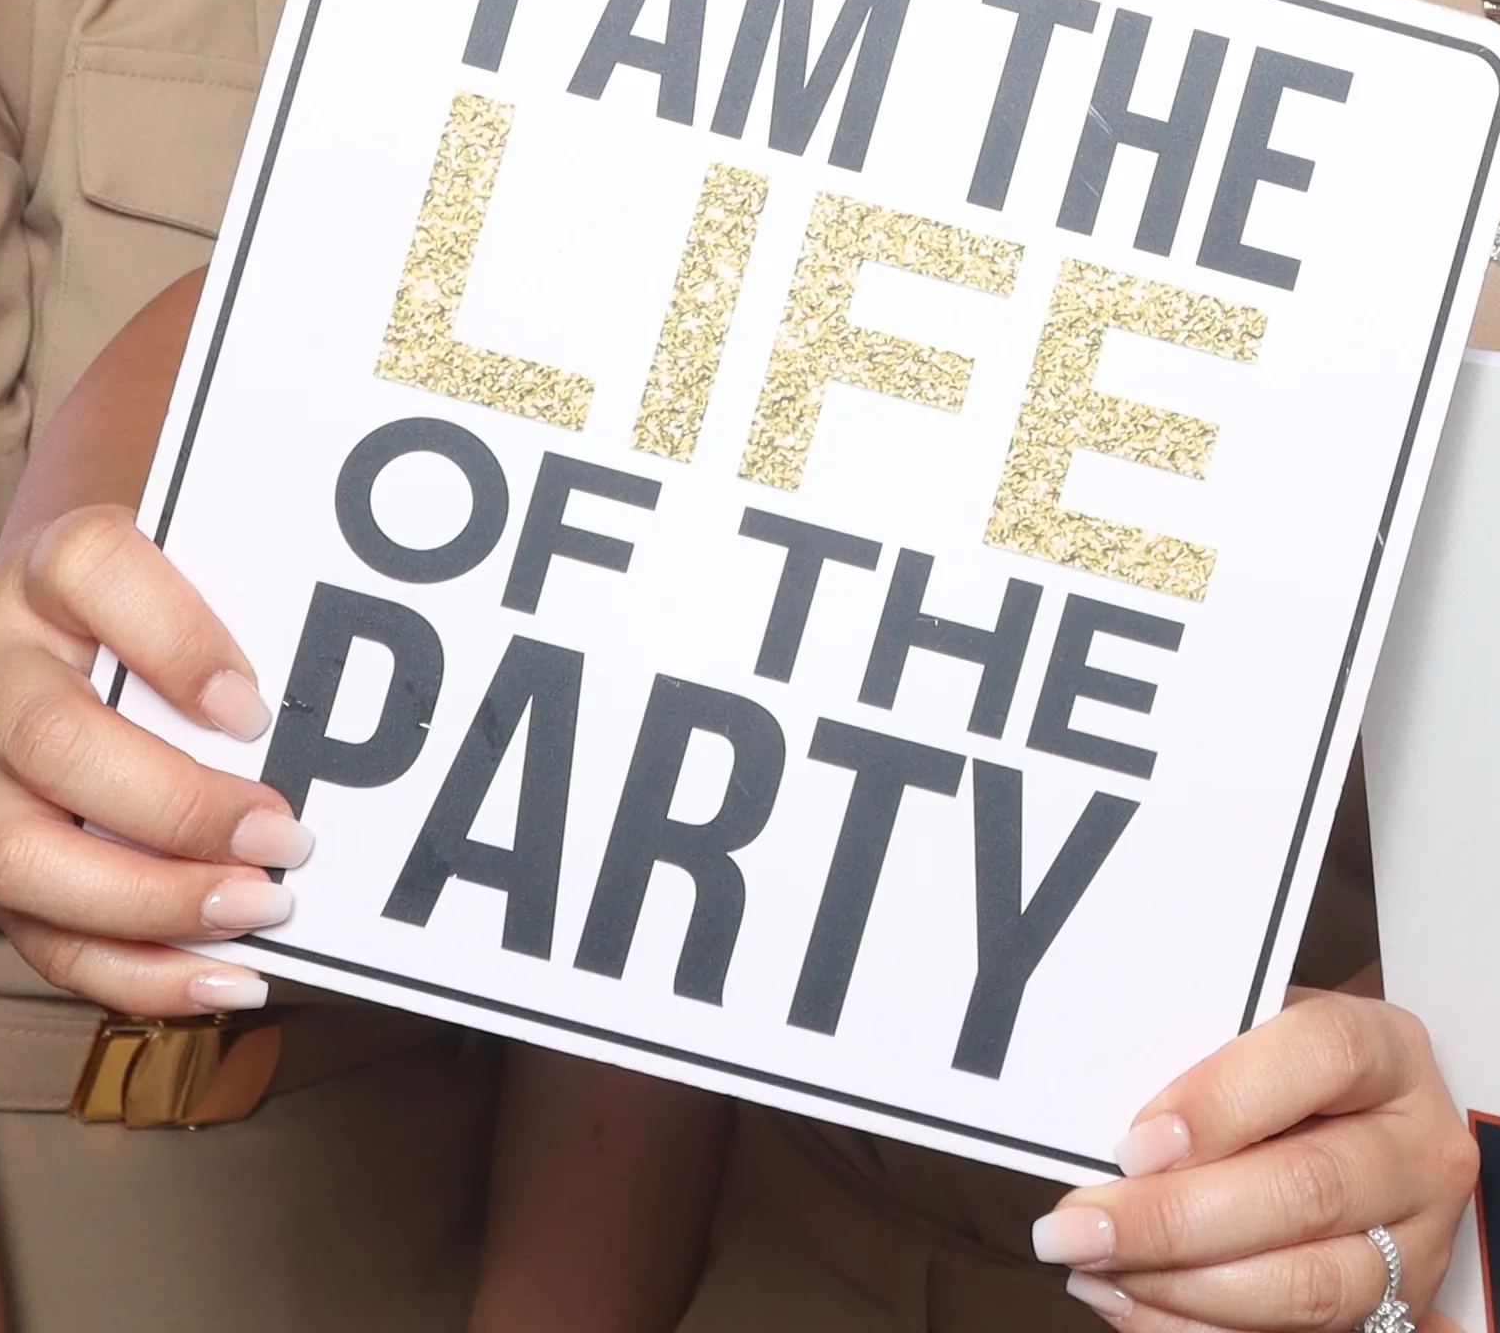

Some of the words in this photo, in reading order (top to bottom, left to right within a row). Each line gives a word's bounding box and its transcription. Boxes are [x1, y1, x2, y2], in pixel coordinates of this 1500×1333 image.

[375, 90, 1269, 603] LIFE
[260, 582, 1142, 1082] PARTY
[333, 416, 664, 613] OF
[735, 506, 1187, 778] THE
